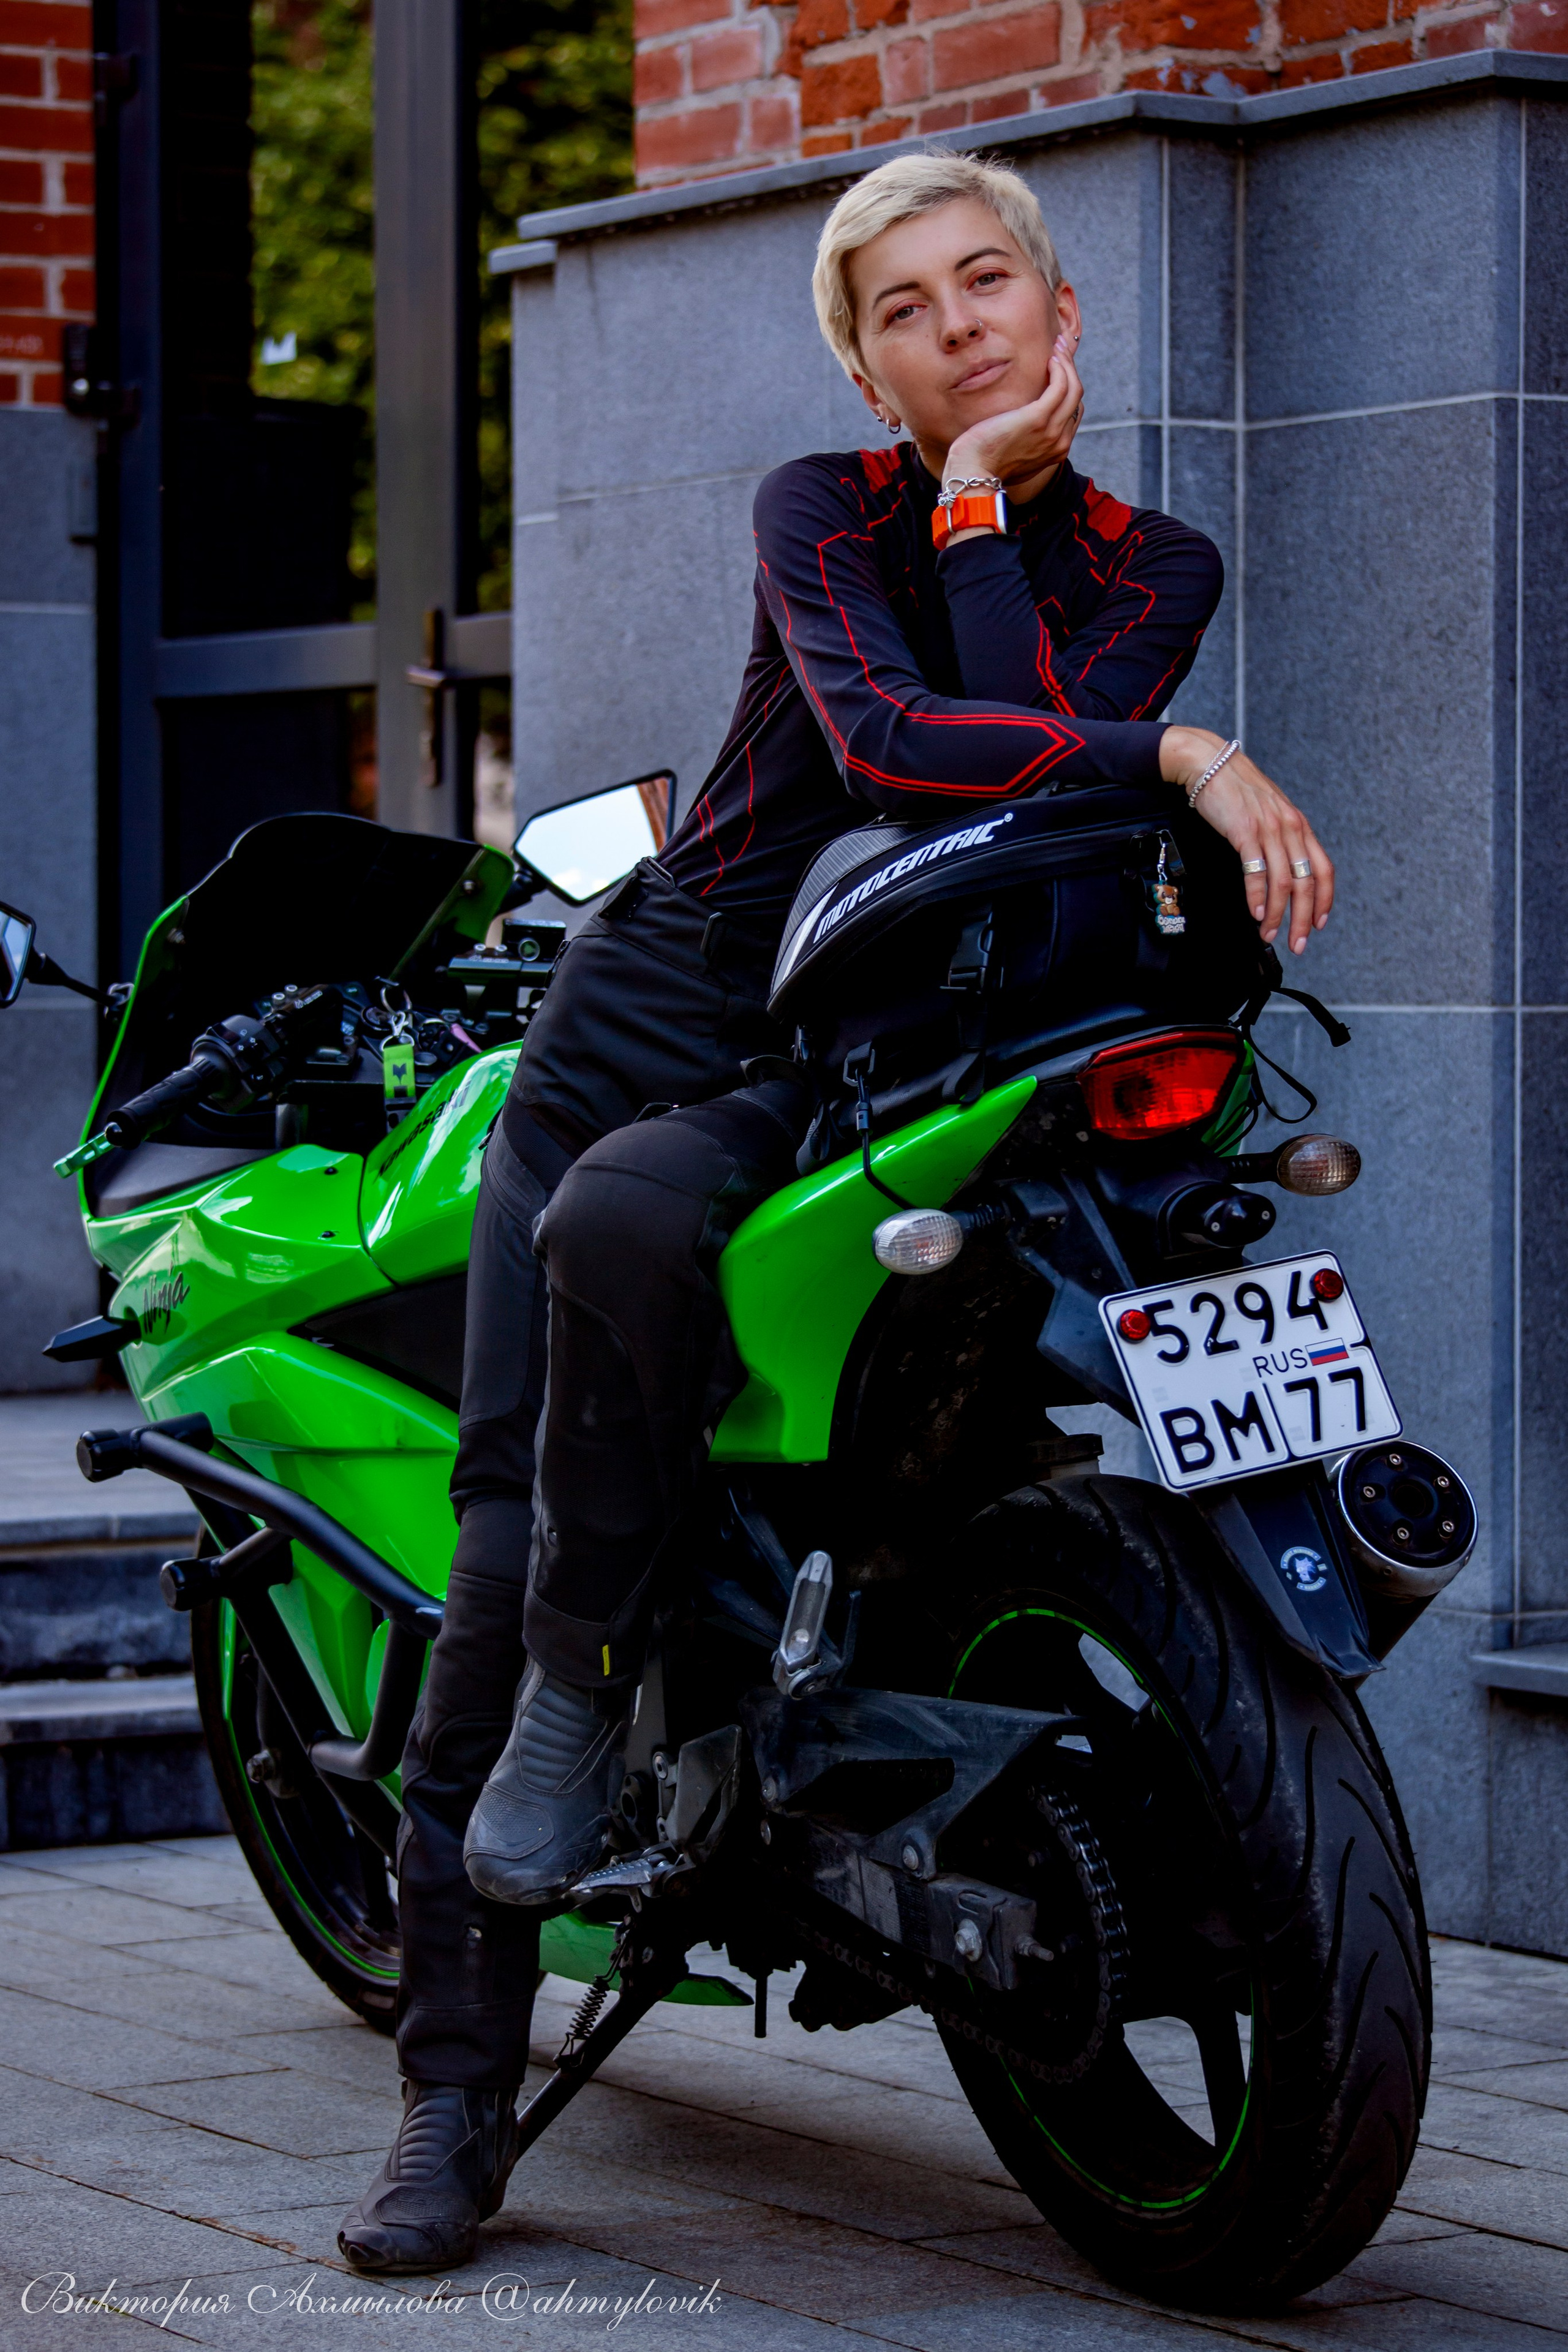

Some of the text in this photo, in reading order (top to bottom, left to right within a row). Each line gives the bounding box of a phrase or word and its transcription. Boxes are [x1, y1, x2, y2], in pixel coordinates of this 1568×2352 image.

[143, 1262, 190, 1335] Ninja
[1142, 1270, 1329, 1363] 5294
[1253, 1348, 1308, 1378] RUS
[1284, 1366, 1366, 1442] 77
